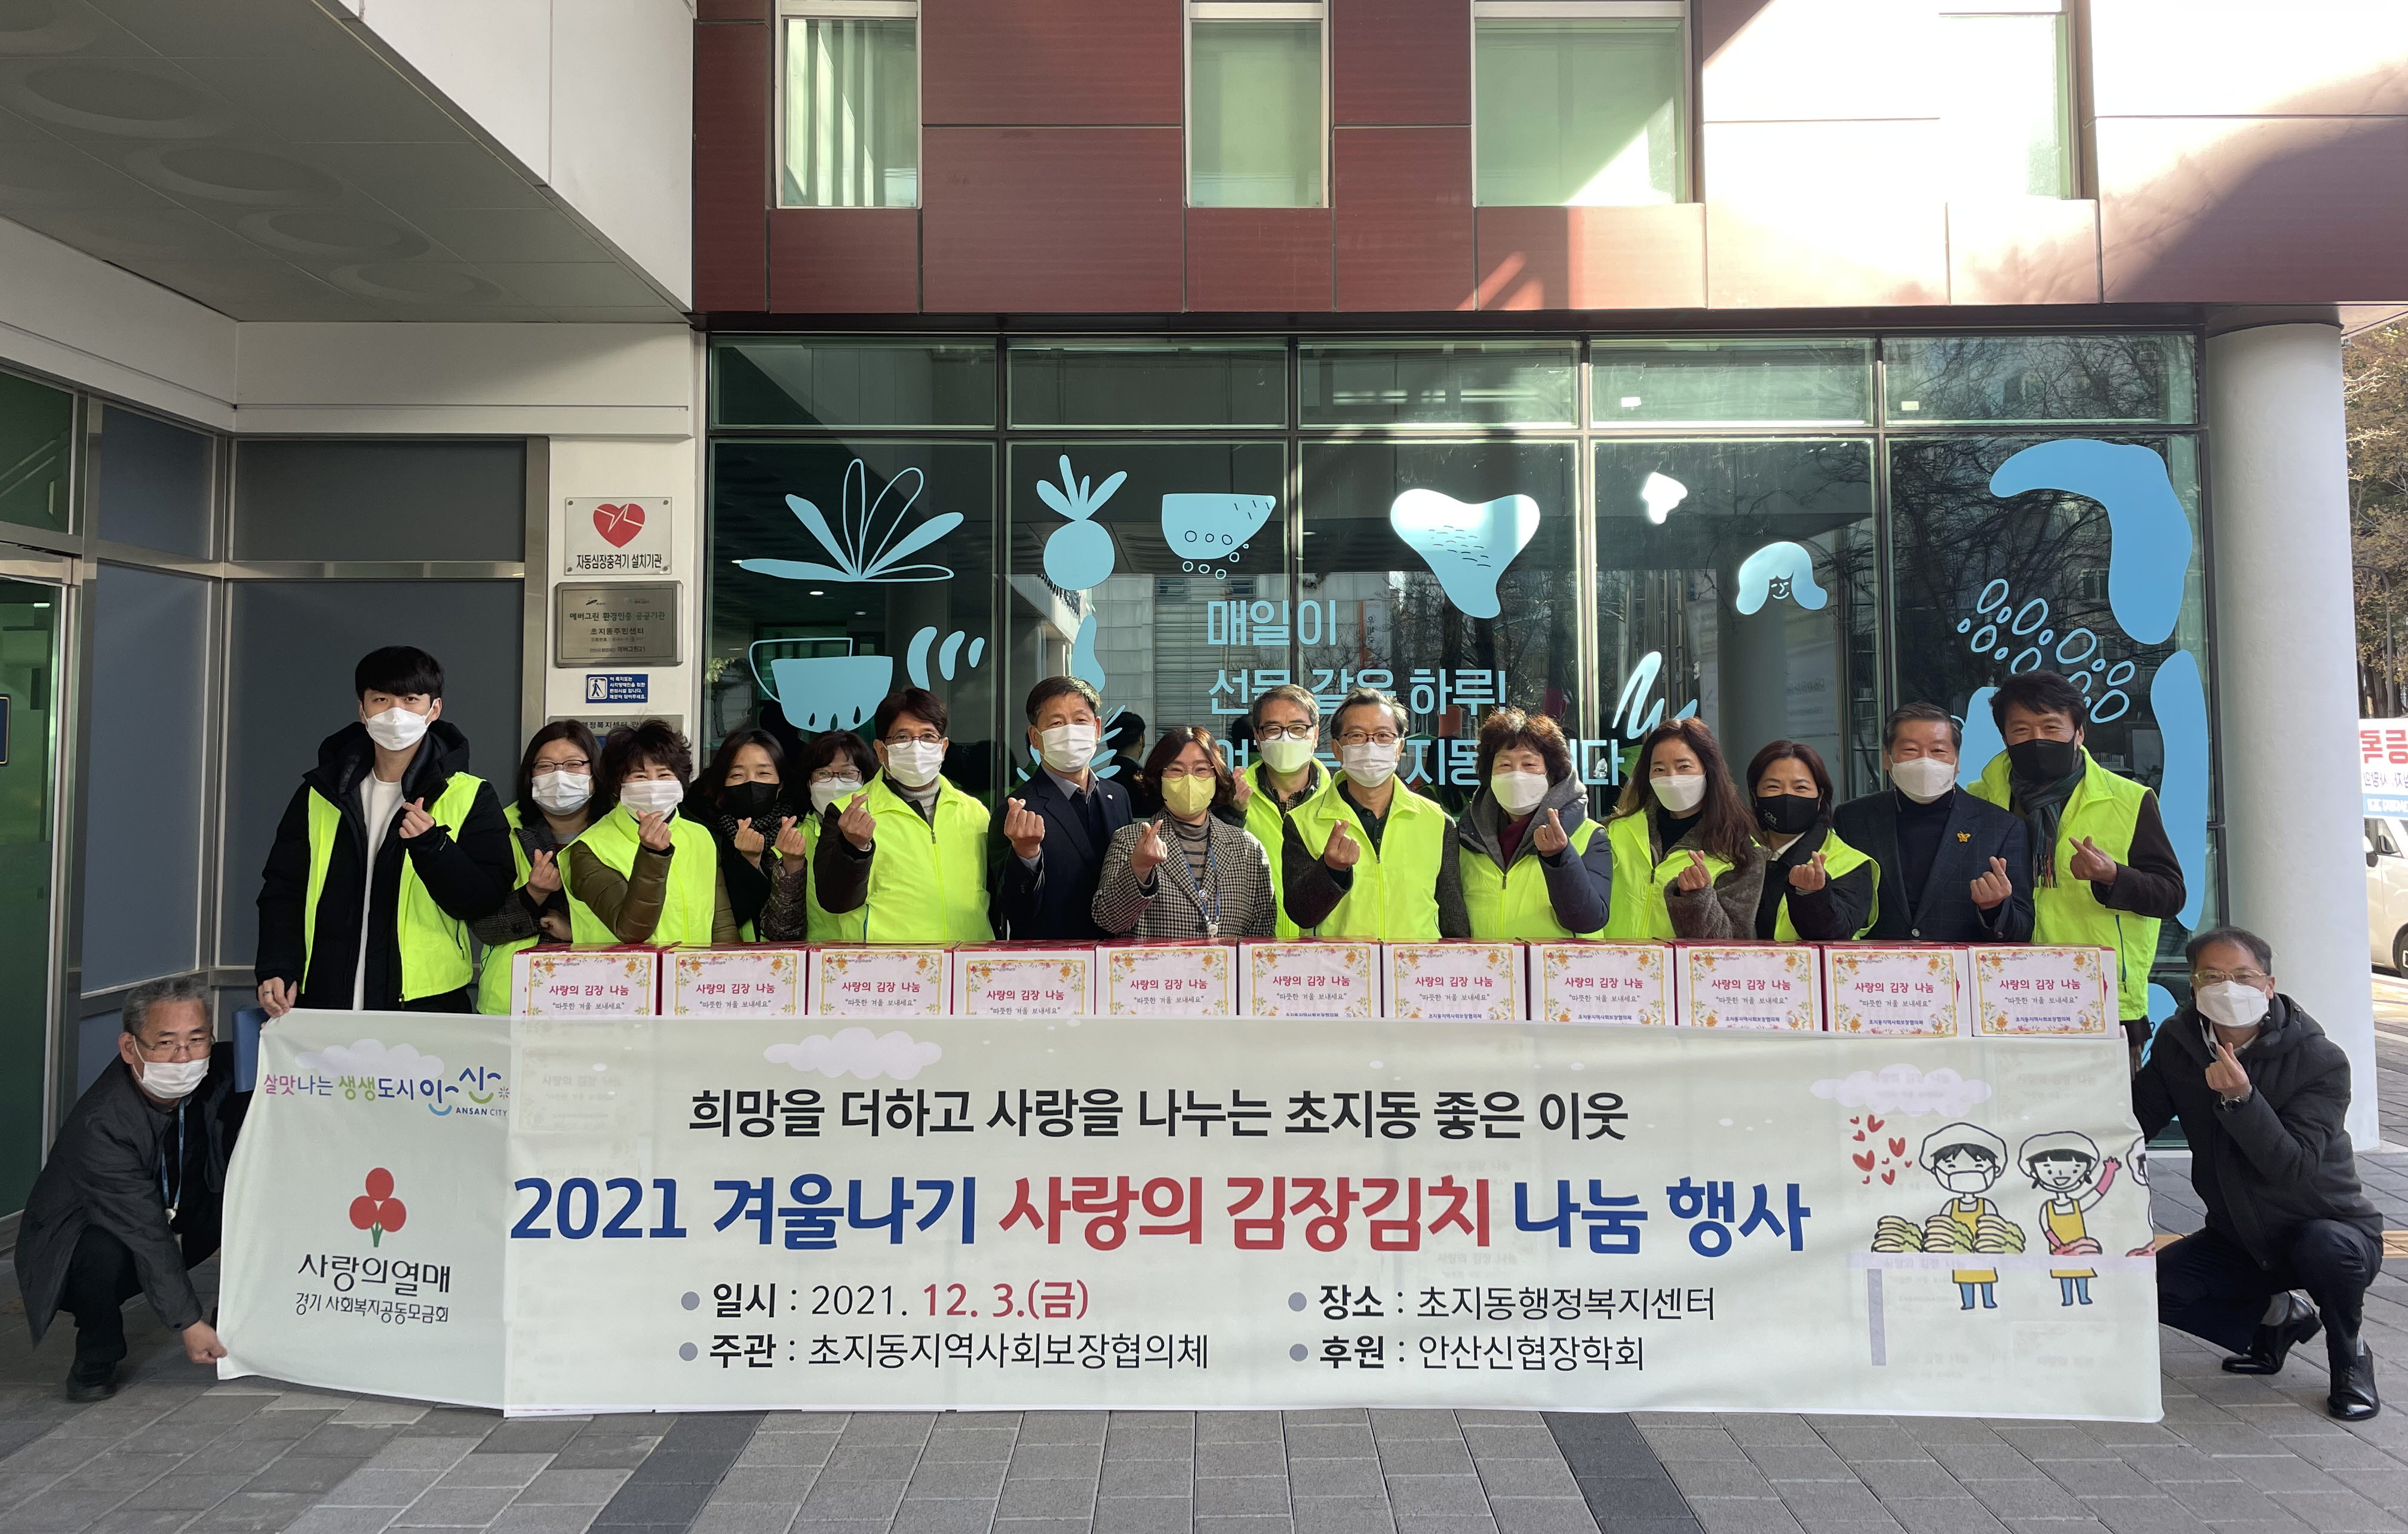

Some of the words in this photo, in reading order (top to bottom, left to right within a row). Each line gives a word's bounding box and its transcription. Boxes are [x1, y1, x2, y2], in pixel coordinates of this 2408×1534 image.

[576, 554, 629, 569] 자동심장충격기
[631, 554, 662, 569] 설치기관
[569, 612, 600, 621] 에버그린
[602, 612, 632, 621] 환경인증
[635, 611, 666, 621] 공공기관
[1207, 600, 1337, 646] 매일이
[590, 627, 644, 636] 초지동주민센터
[1409, 668, 1506, 715] 하루!
[841, 981, 871, 993] 사랑의
[877, 981, 896, 993] 김장
[901, 982, 921, 993] 나눔
[1130, 979, 1159, 991] 사랑의
[1165, 979, 1183, 990] 김장
[1188, 979, 1208, 990] 나눔
[1272, 975, 1301, 987] 사랑의
[1307, 975, 1325, 987] 김장
[1331, 976, 1350, 987] 나눔
[1415, 976, 1444, 987] 사랑의
[1449, 976, 1469, 988] 김장
[1473, 977, 1493, 988] 나눔
[1565, 977, 1594, 989] 사랑의
[1599, 977, 1619, 989] 김장
[1624, 978, 1644, 989] 나눔
[1712, 979, 1742, 990] 사랑의
[1747, 979, 1766, 991] 김장
[1771, 980, 1791, 991] 나눔
[2000, 979, 2030, 991] 사랑의
[2035, 979, 2055, 991] 김장
[2060, 979, 2081, 990] 나눔
[549, 985, 579, 996] 사랑의
[585, 985, 604, 996] 김장
[609, 985, 629, 996] 나눔
[696, 984, 726, 995] 사랑의
[731, 983, 750, 995] 김장
[755, 983, 775, 995] 나눔
[1855, 982, 1884, 994] 사랑의
[1890, 982, 1909, 994] 김장
[1915, 983, 1934, 994] 나눔
[987, 990, 1016, 1001] 사랑의
[1021, 990, 1040, 1002] 김장
[1045, 990, 1064, 1002] 나눔
[1159, 996, 1172, 1004] 겨울
[1302, 992, 1315, 1001] 겨울
[1445, 993, 1458, 1002] 겨울
[1595, 994, 1608, 1004] 겨울
[1742, 996, 1755, 1005] 겨울
[2031, 996, 2045, 1005] 겨울
[578, 1002, 592, 1011] 겨울
[725, 1000, 739, 1009] 겨울
[871, 998, 884, 1007] 겨울
[1885, 999, 1899, 1008] 겨울
[1016, 1007, 1029, 1015] 겨울
[263, 1074, 334, 1097] 살맛나는
[339, 1076, 414, 1101] 생생도시
[455, 1107, 487, 1116] ANSAN
[489, 1108, 508, 1117] CITY
[689, 1088, 825, 1138] 희망을
[841, 1088, 974, 1137] 더하고
[985, 1088, 1124, 1137] 사랑을
[1139, 1088, 1272, 1137] 나누는
[1285, 1090, 1421, 1139] 초지동
[1433, 1091, 1525, 1140] 좋은
[1540, 1091, 1629, 1141] 이웃
[510, 1177, 687, 1240] 2021
[714, 1174, 975, 1250] 겨울나기
[999, 1176, 1202, 1251] 사랑의
[1226, 1175, 1490, 1252] 김장김치
[1515, 1179, 1647, 1254] 나눔
[1666, 1176, 1811, 1258] 행사
[297, 1253, 452, 1297] 사랑의열매
[713, 1283, 776, 1318] 일시
[811, 1284, 908, 1317] 2021.
[923, 1283, 978, 1318] 12.
[992, 1279, 1089, 1320] 3.(금)
[1319, 1284, 1384, 1320] 장소
[1417, 1285, 1715, 1321] 초지동행정복지센터
[295, 1292, 322, 1316] 경기
[325, 1294, 450, 1326] 사회복지공동모금회
[709, 1333, 777, 1369] 주관
[807, 1332, 1209, 1370] 초지동지역사회보장협의체
[1319, 1335, 1385, 1369] 후원
[1418, 1335, 1644, 1372] 안산신협장학회
